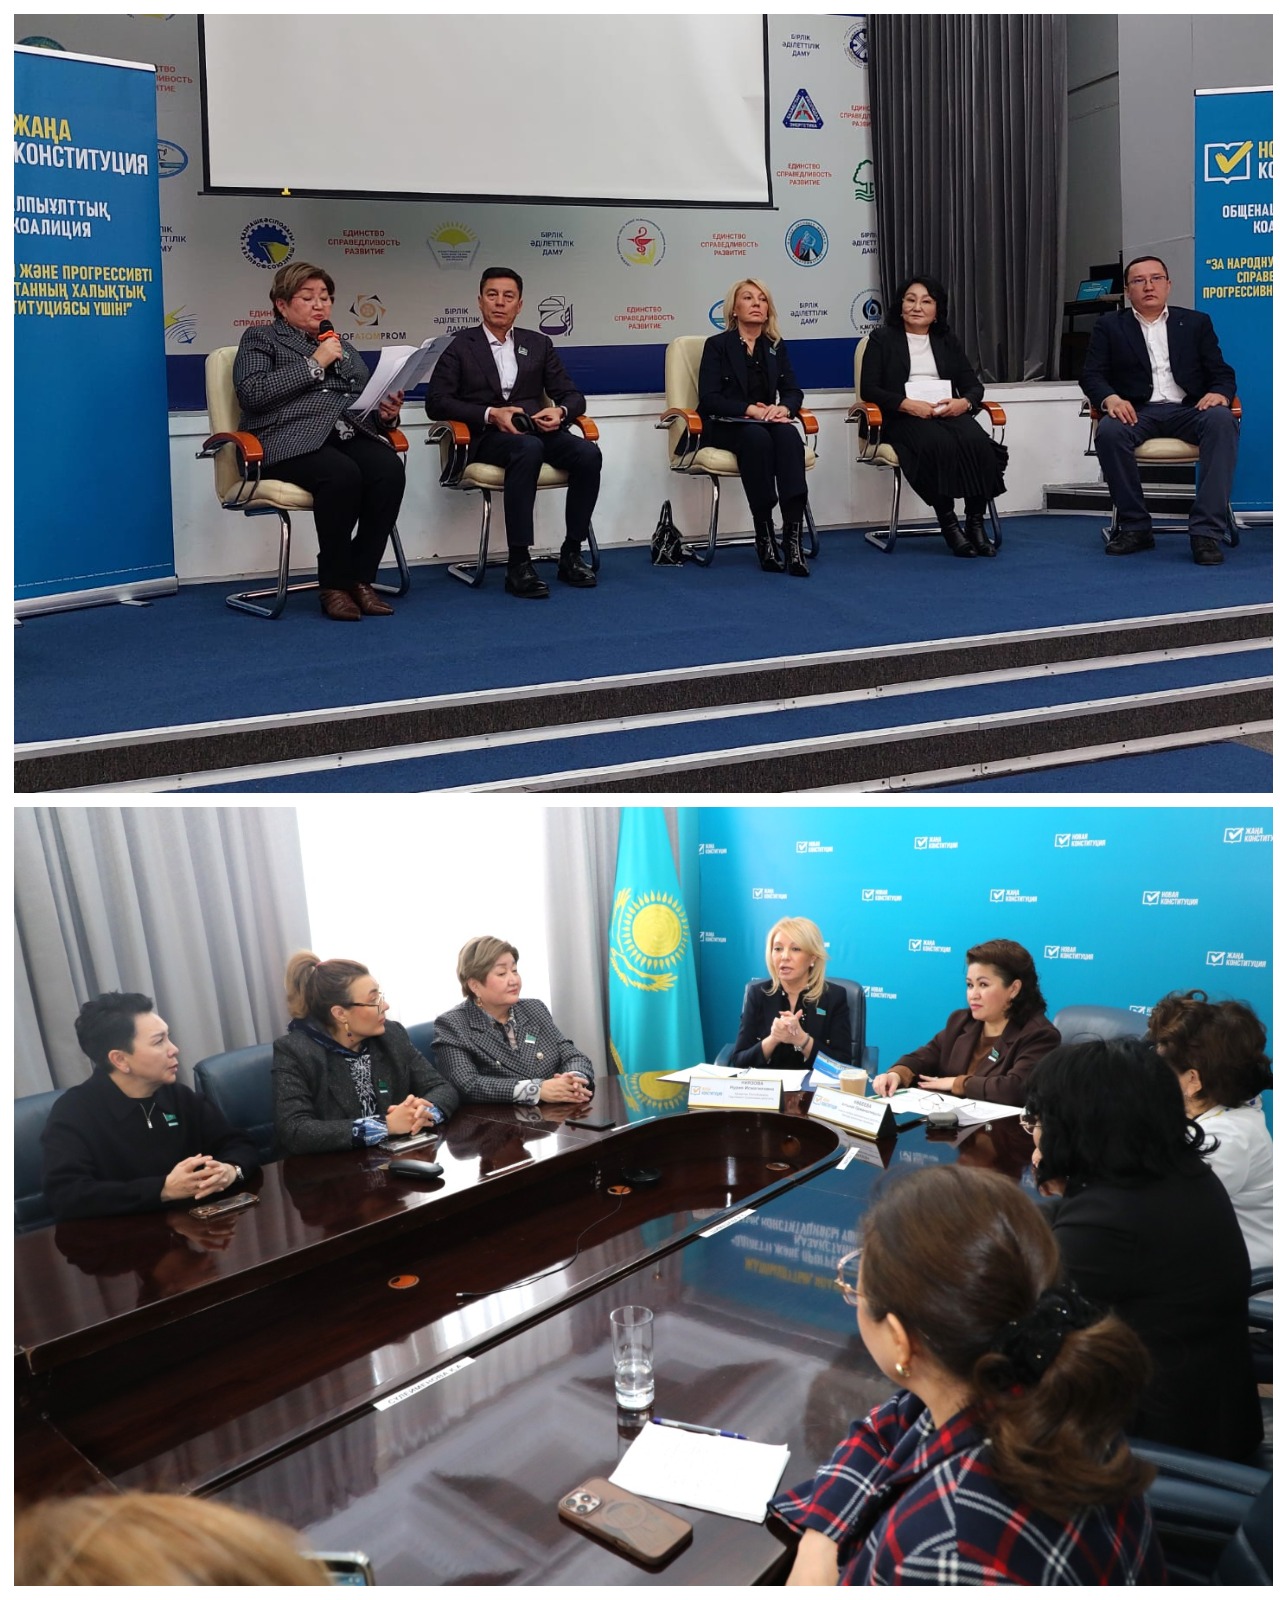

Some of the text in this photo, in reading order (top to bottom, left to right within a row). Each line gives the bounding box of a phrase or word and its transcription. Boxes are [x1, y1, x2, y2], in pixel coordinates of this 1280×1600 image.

[14, 114, 72, 144] ЖАҢА
[14, 141, 149, 175] КОНСТИТУЦИЯ
[14, 195, 111, 221] ЛПЫҰЛТТЫҚ
[342, 229, 385, 237] ЕДИНСТВО
[328, 238, 400, 247] СПРАВЕДЛИВОСТЬ
[700, 241, 759, 249] СПРАВЕДЛИВОСТЬ
[20, 263, 58, 280] ЖӘНЕ
[62, 265, 152, 282] ПРОГРЕССИВТІ
[72, 283, 146, 302] ХАЛЫҚТЫҚ
[444, 307, 469, 315] БІРЛІК
[433, 316, 481, 325] ӘДІЛЕТТІЛІК
[614, 314, 675, 322] СПРАВЕДЛИВОСТЬ
[1245, 827, 1264, 836] ЖАҢА
[1071, 833, 1088, 841] НОВАЯ
[1071, 839, 1106, 847] КОНСТИТУЦИЯ
[1006, 889, 1020, 897] ЖАҢА
[1005, 895, 1037, 903] КОНСТИТУЦИЯ
[1160, 898, 1198, 906] КОНСТИТУЦИЯ
[1060, 952, 1094, 961] КОНСТИТУЦИЯ
[1226, 952, 1244, 960] ЖАҢА
[1225, 959, 1266, 968] КОНСТИТУЦИЯ
